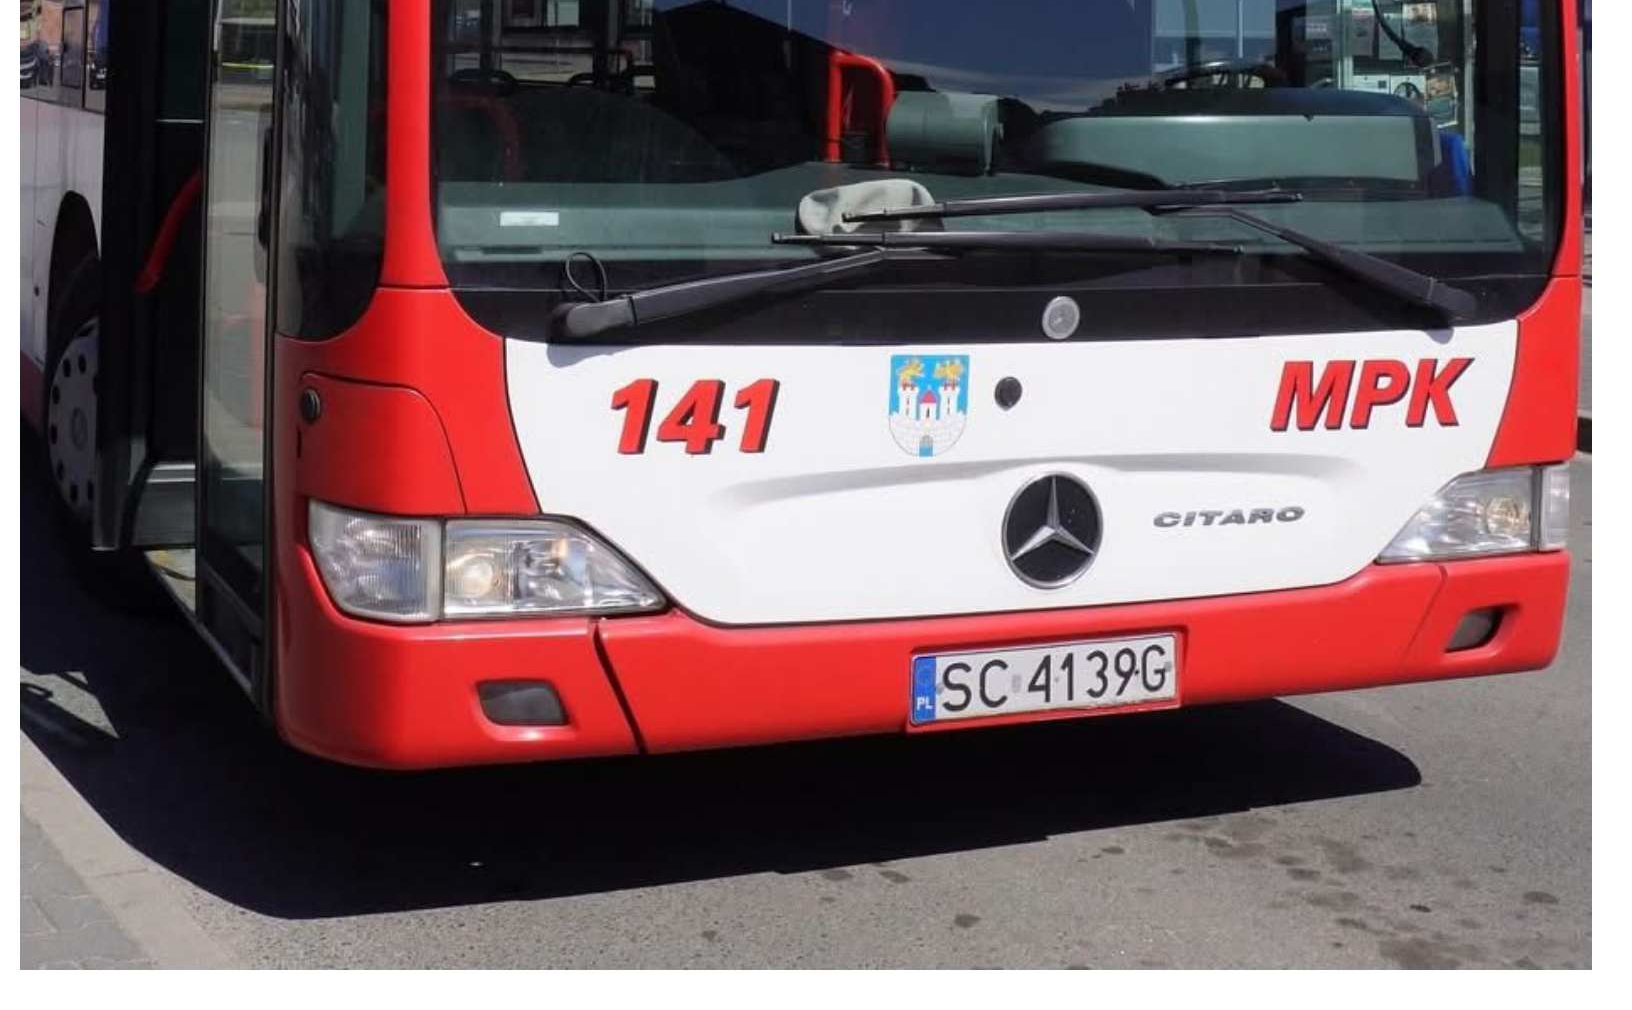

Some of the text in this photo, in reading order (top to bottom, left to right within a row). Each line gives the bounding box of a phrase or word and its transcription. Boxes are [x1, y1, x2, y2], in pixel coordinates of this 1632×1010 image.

[611, 378, 780, 455] 141
[1270, 358, 1475, 431] MPK
[1153, 506, 1305, 528] CITARO
[917, 696, 934, 711] PL
[942, 644, 1166, 712] SC 4139G
